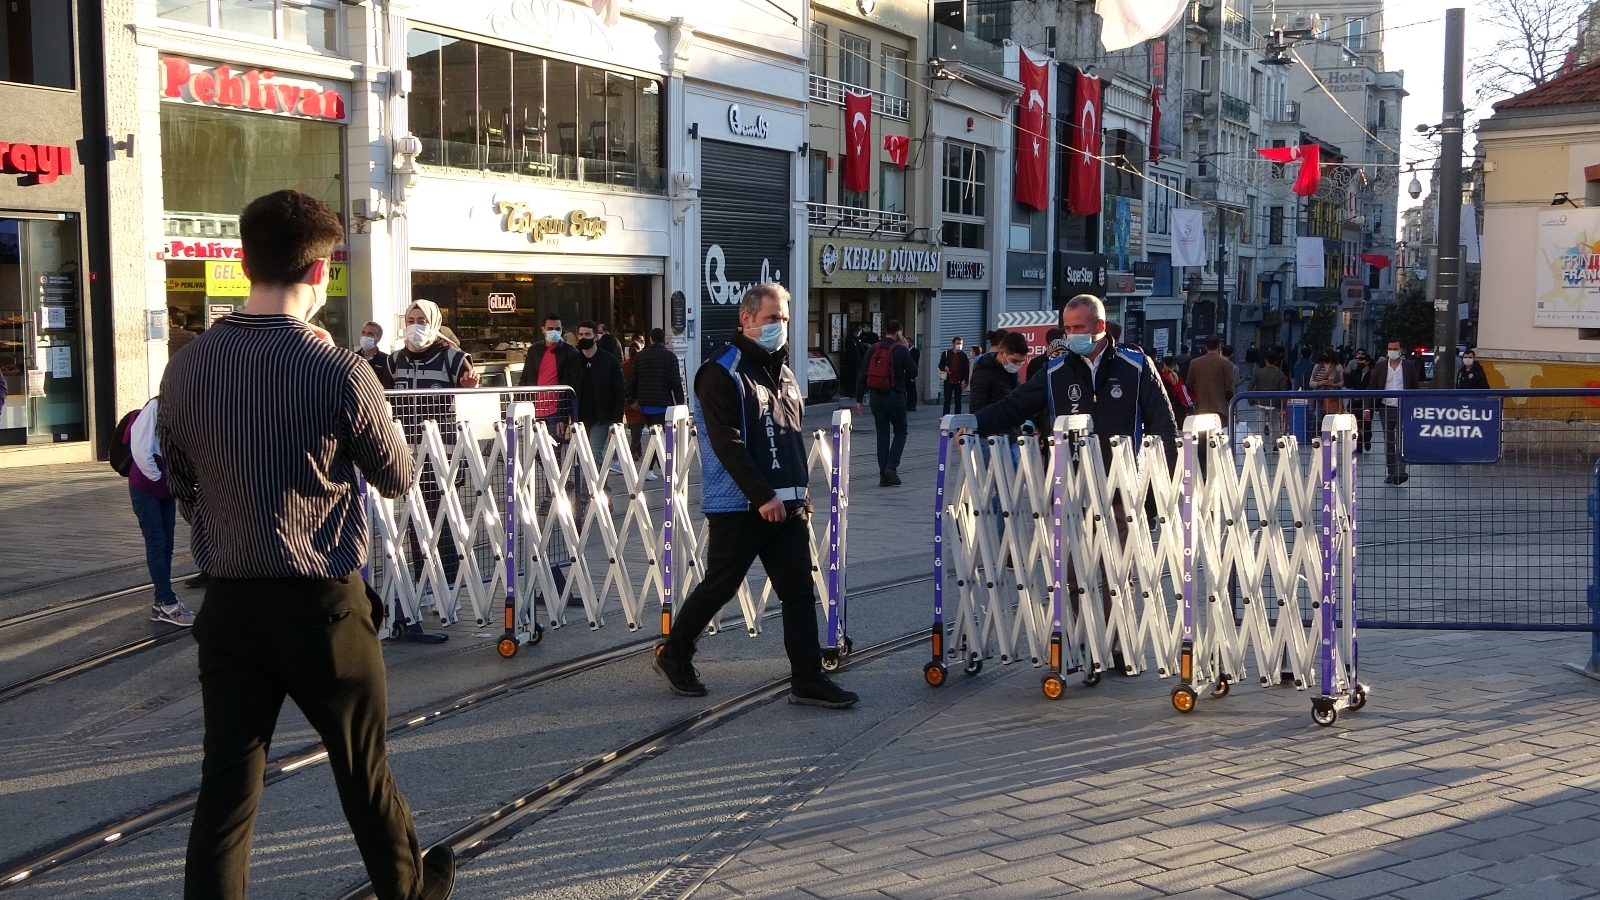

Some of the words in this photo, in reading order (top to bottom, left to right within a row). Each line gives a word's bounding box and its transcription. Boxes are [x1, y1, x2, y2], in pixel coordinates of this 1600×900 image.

[158, 57, 345, 119] Pehlivan
[1328, 70, 1364, 83] Hotel
[728, 103, 769, 138] Bambi
[170, 241, 244, 259] Pehliva
[842, 246, 886, 270] KEBAP
[889, 246, 942, 272] DÜNYASI
[1067, 266, 1093, 286] SuperStep
[491, 295, 515, 312] GÜLLAÇ
[1413, 405, 1493, 421] BEYOĞLU
[763, 405, 781, 469] ZABITA
[1419, 424, 1483, 438] ZABITA
[664, 452, 672, 596] BEYOĞLU
[830, 467, 838, 571] ZABITA
[934, 463, 945, 615] BEYOĞLU
[1184, 469, 1192, 635] BEYOĞLU
[1323, 481, 1331, 604] ZABITA
